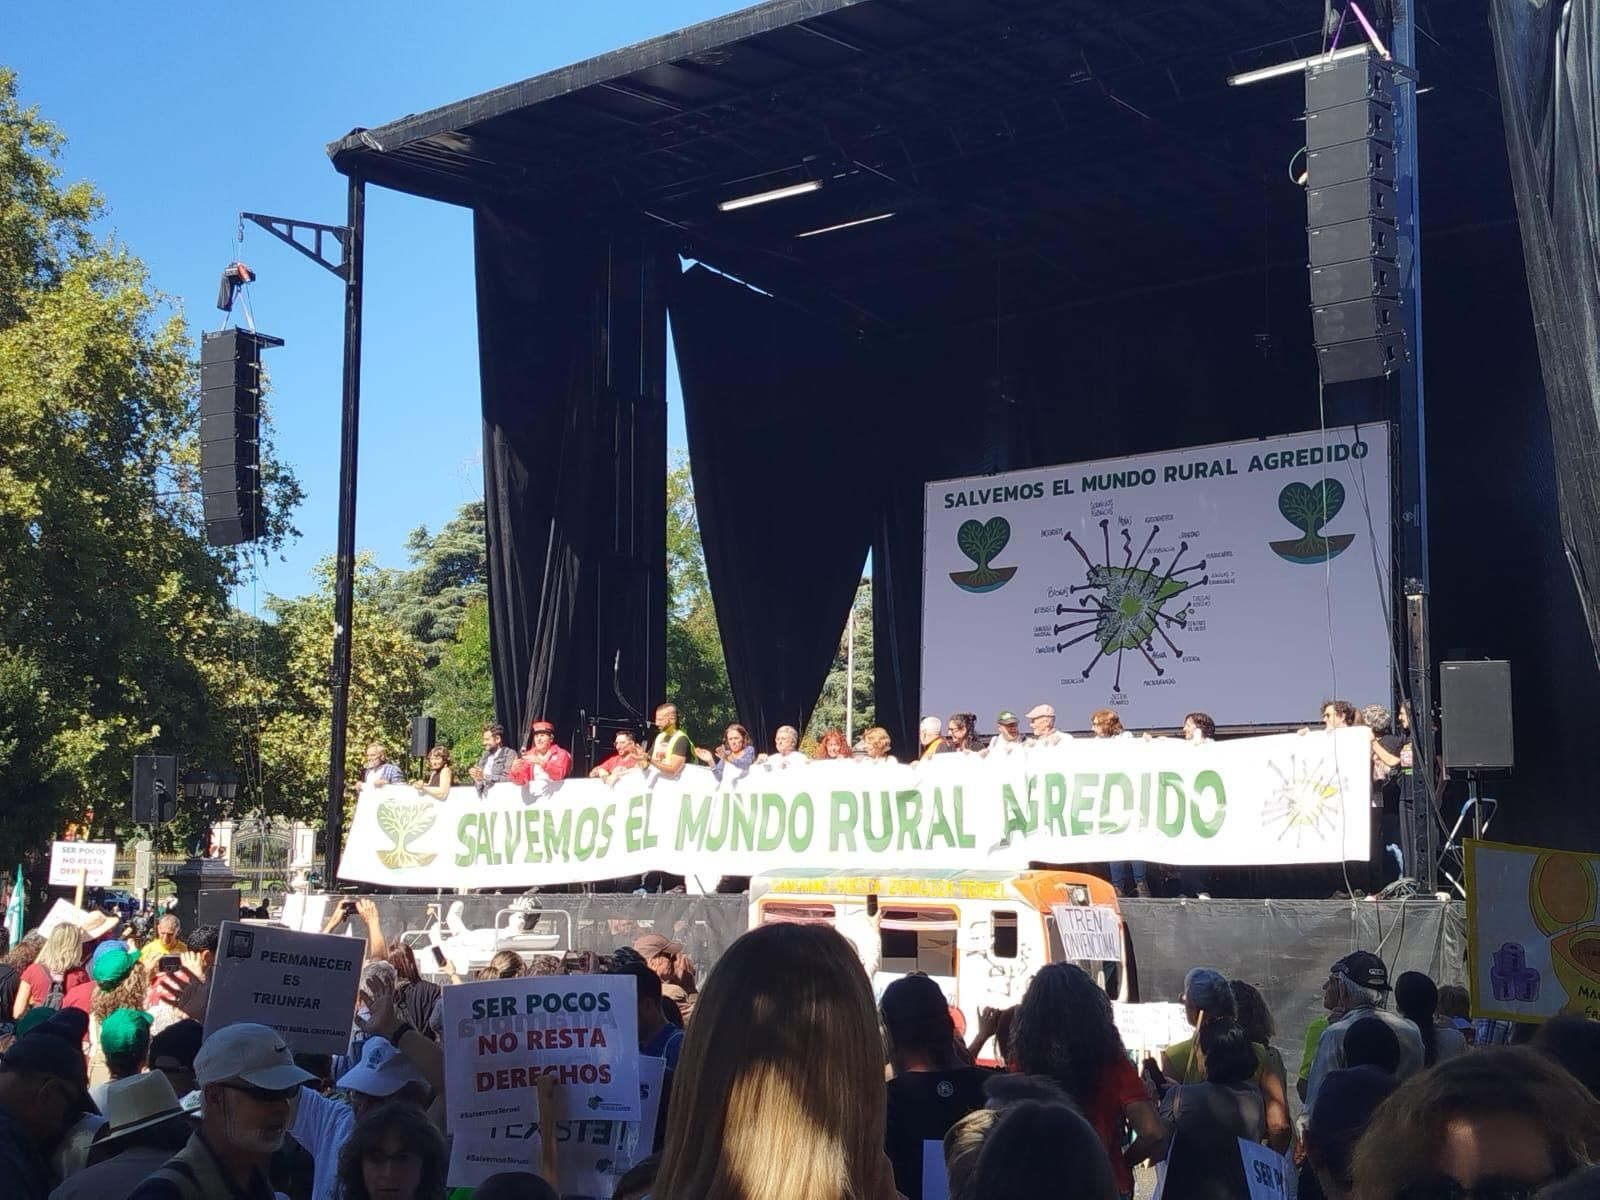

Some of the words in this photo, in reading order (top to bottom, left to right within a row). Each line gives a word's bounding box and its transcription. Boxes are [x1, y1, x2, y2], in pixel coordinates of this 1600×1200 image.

[944, 482, 1044, 509] SALVEMOS
[1052, 479, 1074, 496] EL
[1081, 468, 1156, 493] MUNDO
[1164, 458, 1238, 482] RURAL
[1247, 441, 1369, 472] AGREDIDO
[454, 803, 616, 867] SALVEMOS
[625, 792, 658, 851] EL
[674, 790, 815, 853] MUNDO
[828, 784, 977, 853] RURAL
[1002, 769, 1228, 846] AGREDIDO
[62, 846, 76, 854] SER
[79, 847, 107, 855] POCOS
[1065, 908, 1103, 932] TREN
[260, 950, 352, 971] PERMANECER
[283, 974, 301, 987] ES
[252, 992, 321, 1010] TRIUNFAR
[471, 996, 517, 1020] SER
[526, 991, 611, 1015] POCOS
[311, 1027, 346, 1037] CRISTIANO
[478, 1031, 518, 1056] NO
[526, 1027, 607, 1051] RESTA
[1253, 1159, 1275, 1190] SER
